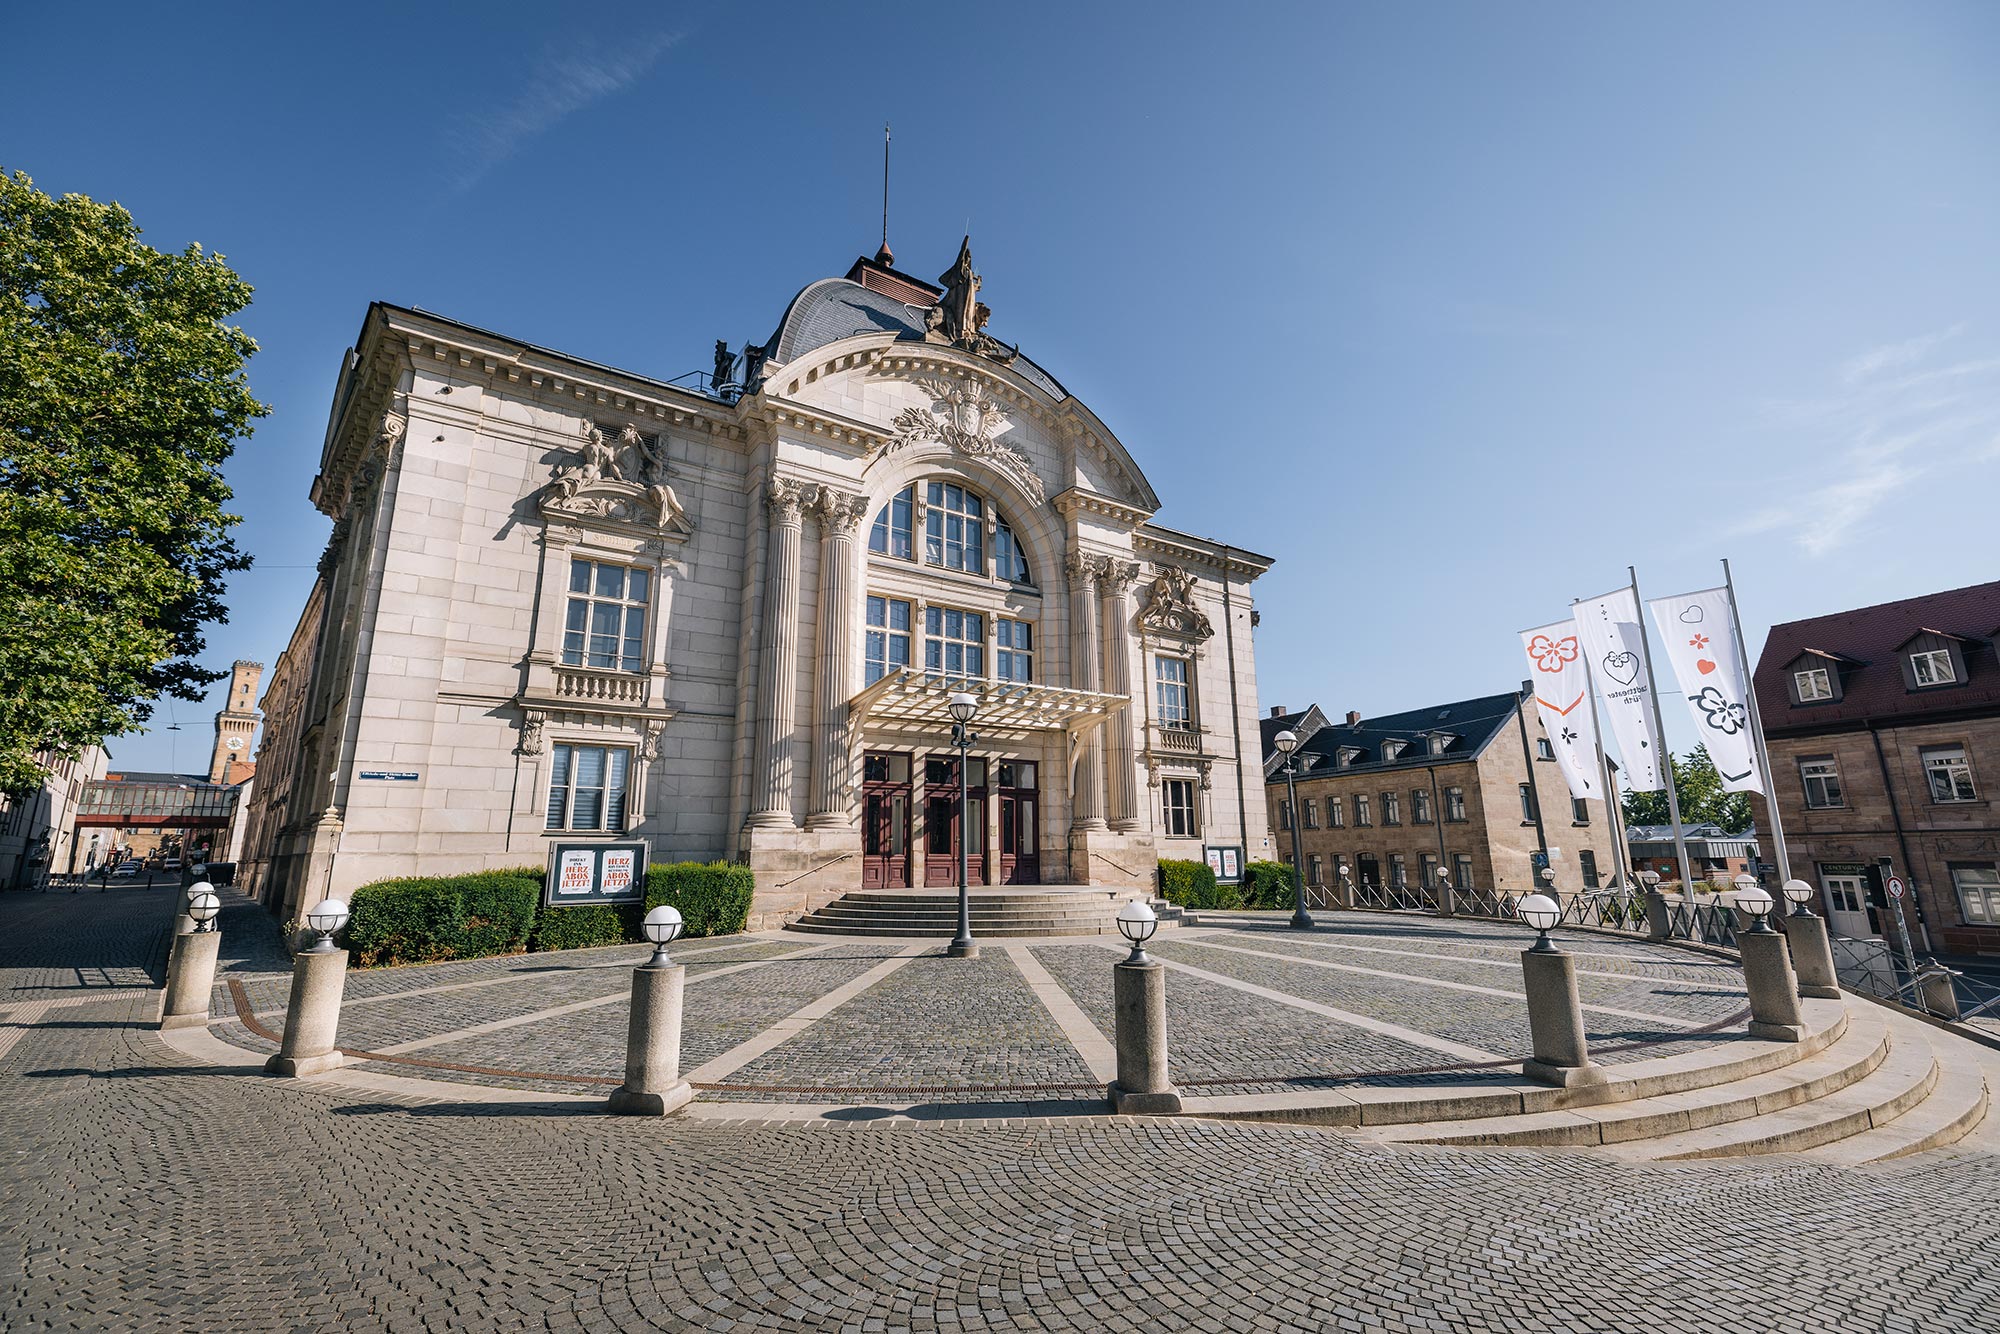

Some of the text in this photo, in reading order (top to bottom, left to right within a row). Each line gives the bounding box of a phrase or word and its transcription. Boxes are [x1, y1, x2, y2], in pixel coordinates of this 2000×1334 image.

[60, 831, 70, 844] 7
[561, 879, 590, 888] JETZT!
[603, 878, 631, 888] JETZT!
